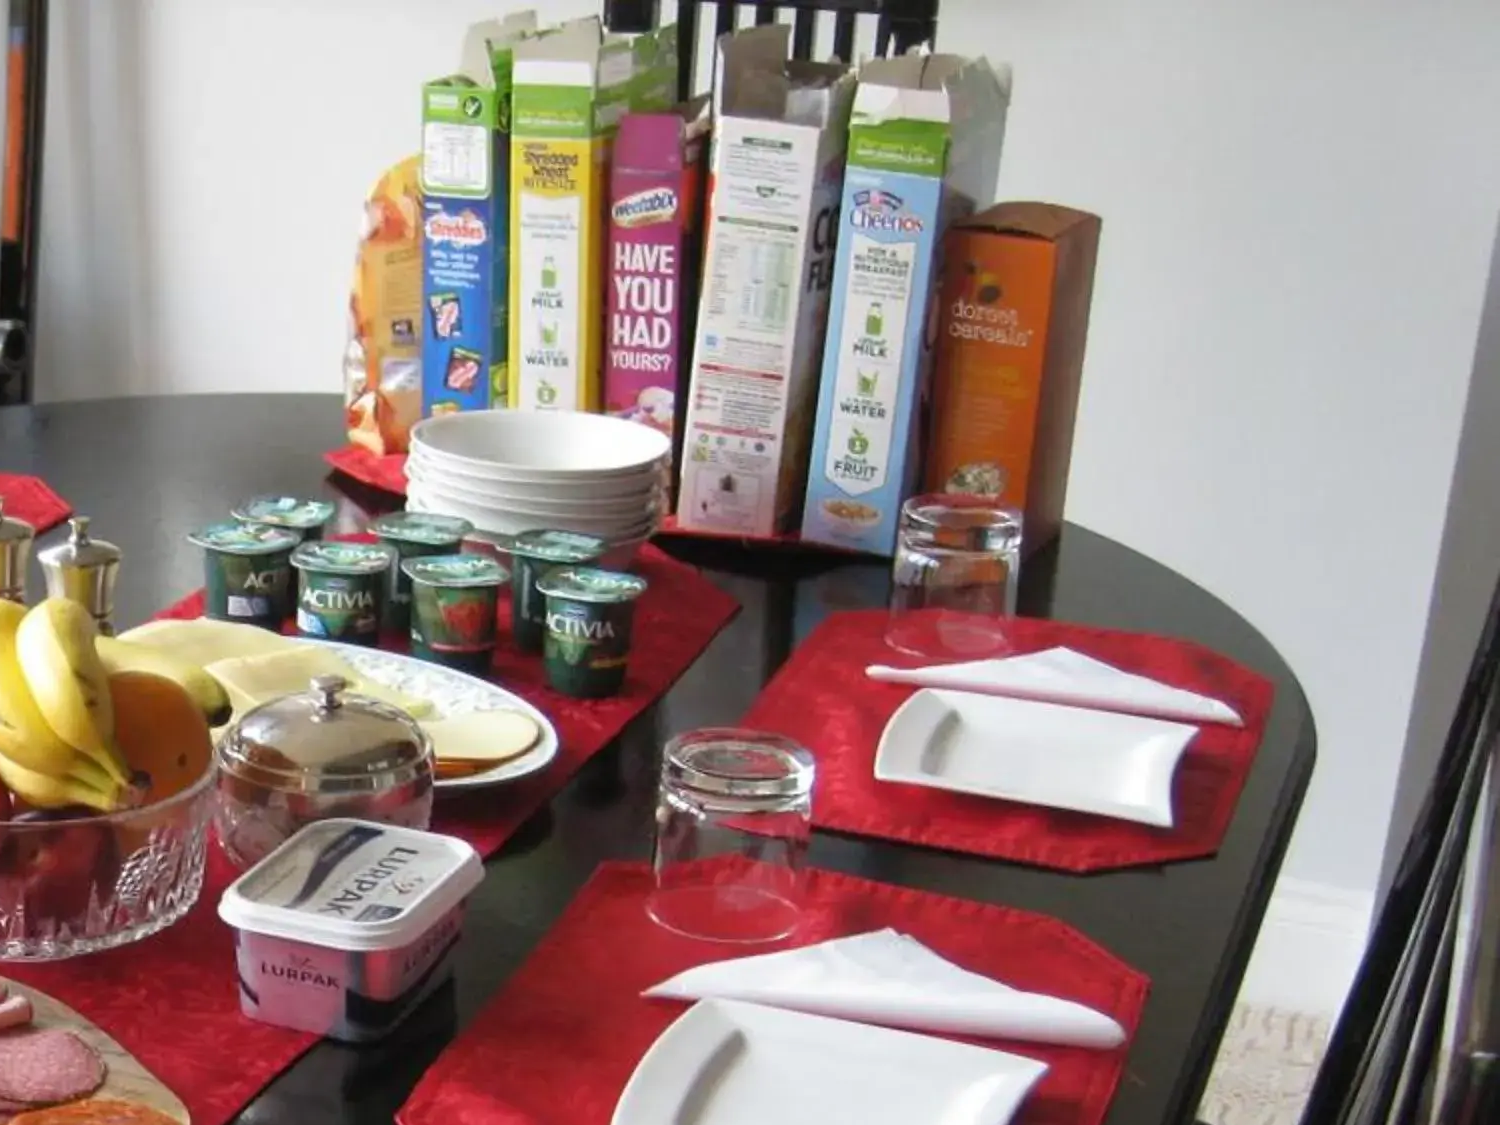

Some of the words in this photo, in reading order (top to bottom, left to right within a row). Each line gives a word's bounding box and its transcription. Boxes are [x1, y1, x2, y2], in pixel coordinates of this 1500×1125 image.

[850, 207, 924, 233] Cheerios
[614, 241, 675, 274] HAVE
[531, 296, 563, 309] MILK
[613, 274, 674, 315] YOU
[953, 300, 1018, 326] dorset
[613, 313, 672, 350] HAD
[525, 354, 569, 368] WATER
[611, 350, 673, 373] YOURS?
[852, 343, 888, 358] MILK
[840, 401, 886, 419] WATER
[834, 460, 878, 479] FRUIT
[303, 587, 374, 610] ACTIVIA
[320, 846, 420, 916] LURPAK
[261, 962, 340, 990] LURPAK
